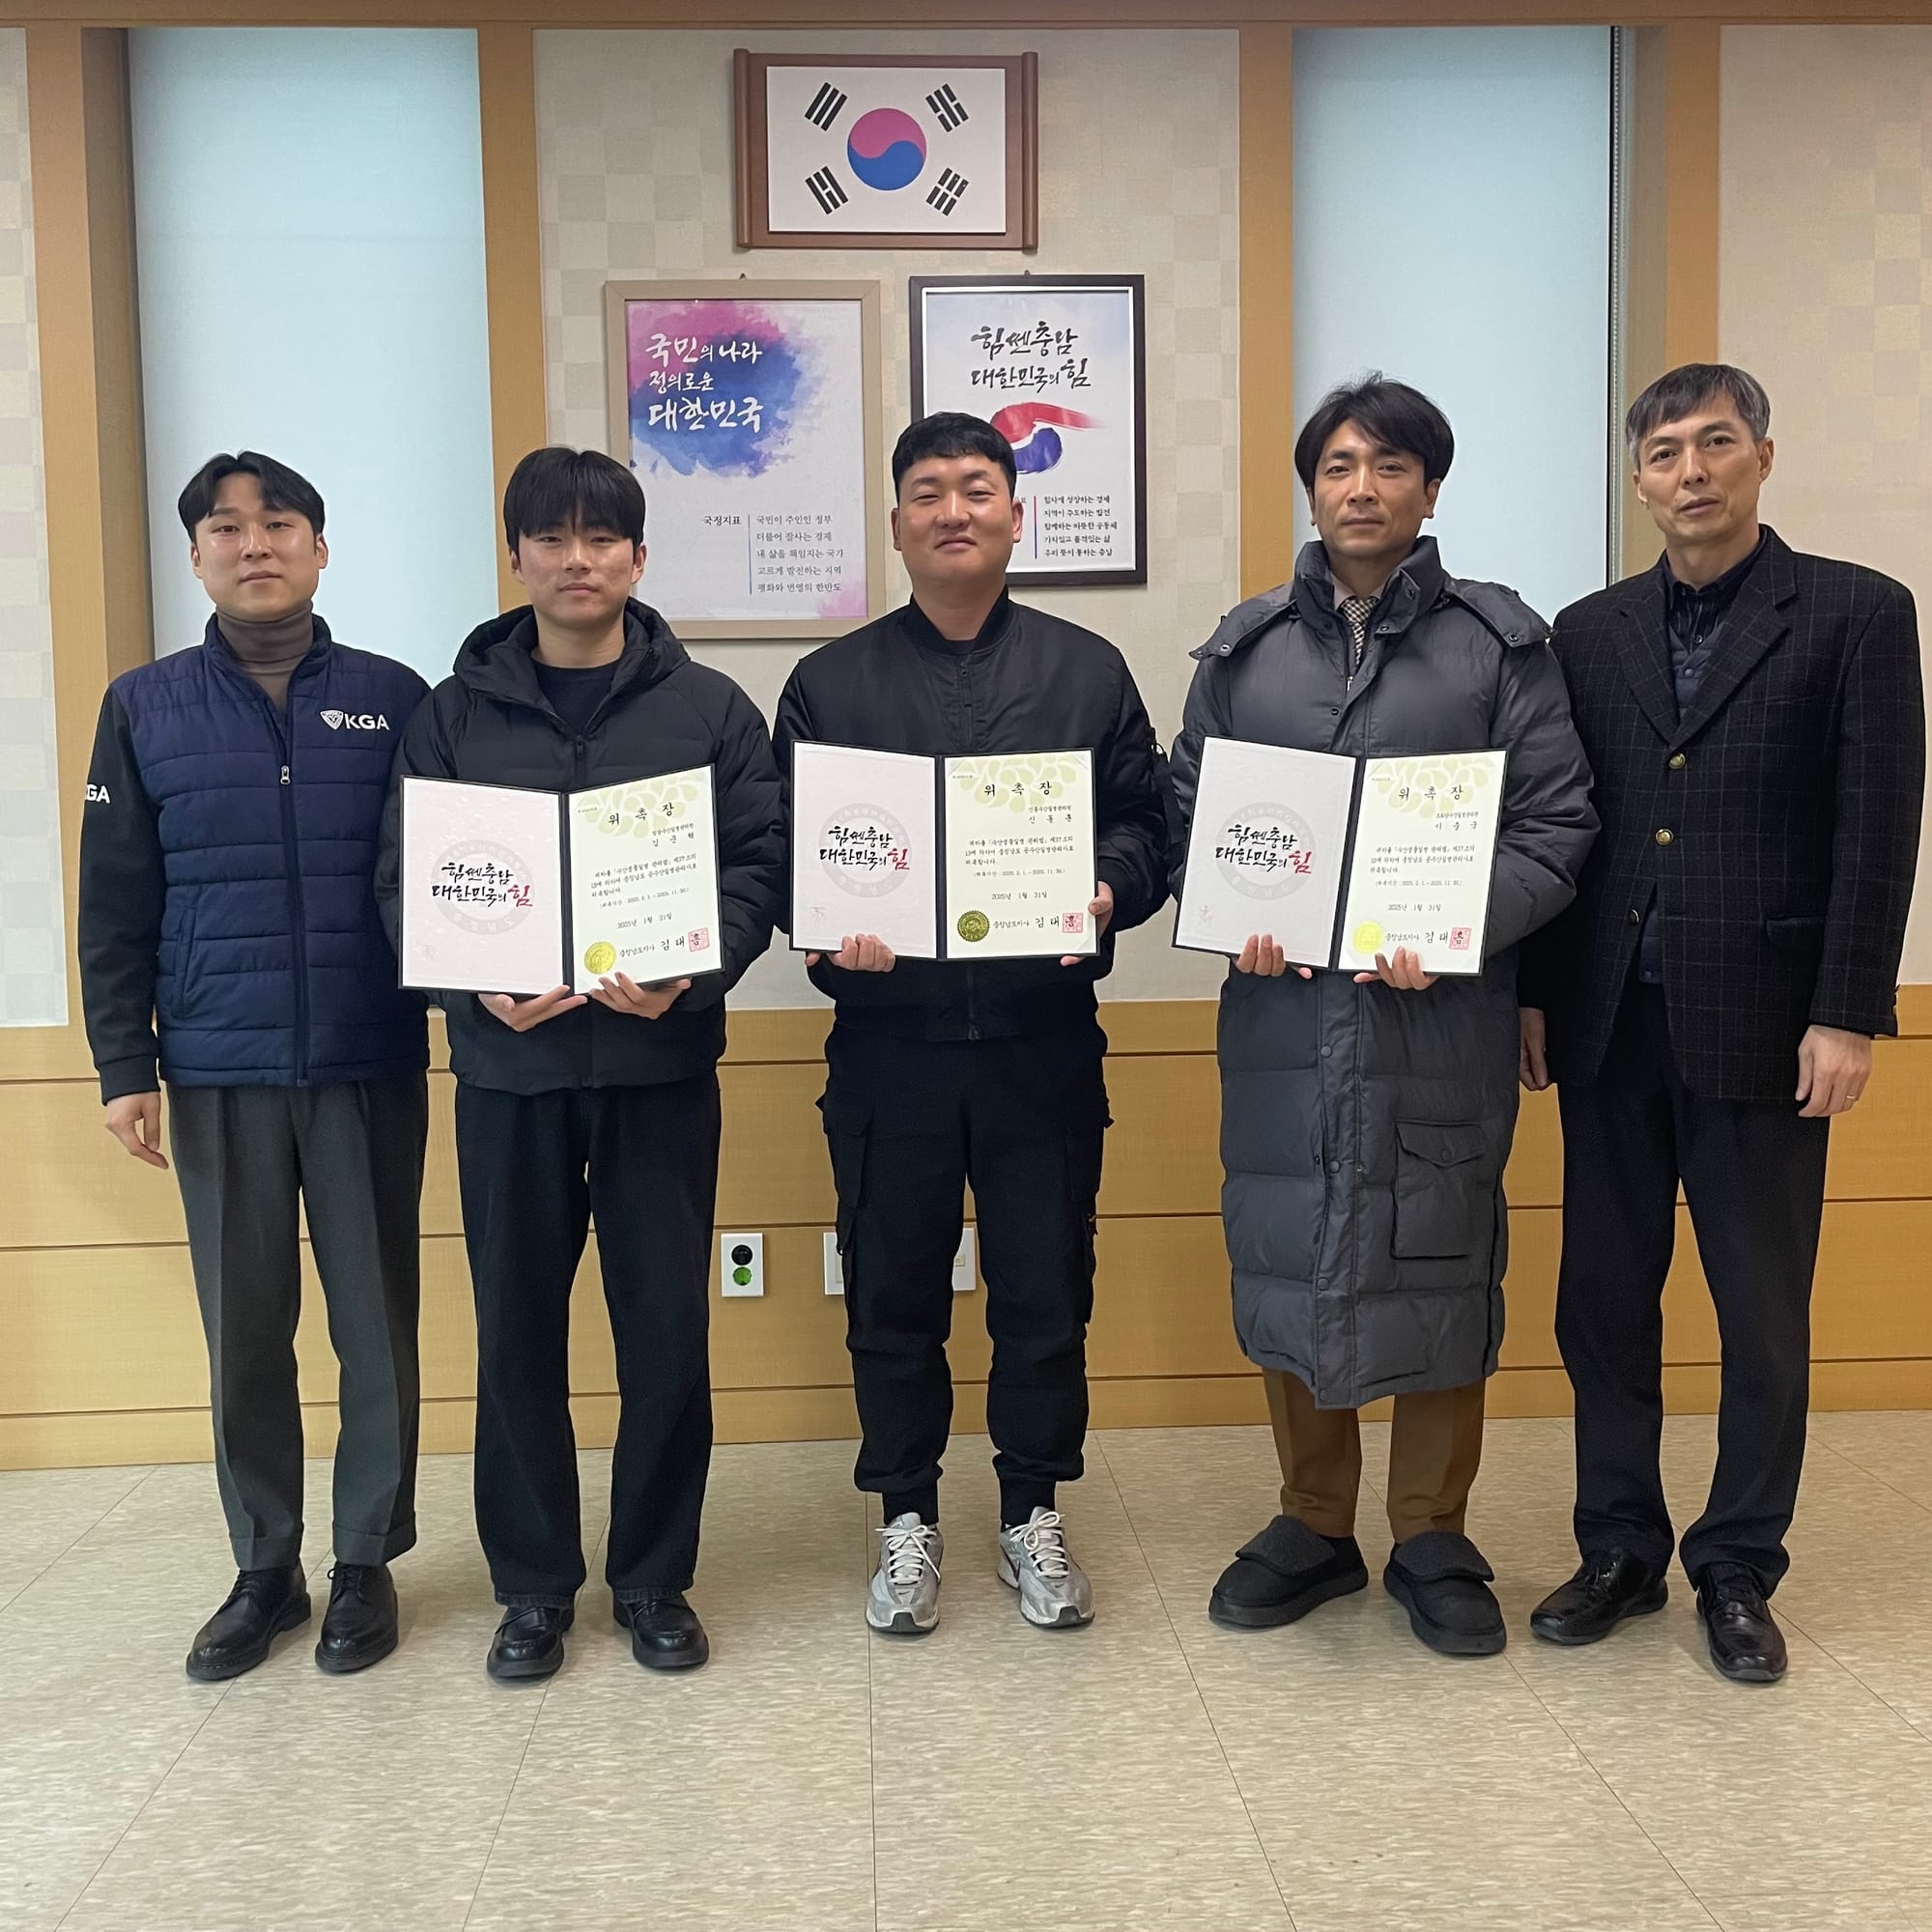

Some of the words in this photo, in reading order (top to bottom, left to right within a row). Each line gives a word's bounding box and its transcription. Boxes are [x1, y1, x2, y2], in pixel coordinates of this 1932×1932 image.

[645, 332, 713, 367] 국민의
[719, 340, 763, 364] 나라
[649, 371, 715, 394] 정의로운
[648, 396, 765, 433] 대한민국
[703, 515, 742, 526] 국정지표
[756, 514, 782, 526] 국민이
[785, 514, 811, 526] 주인인
[815, 514, 833, 526] 정부
[756, 531, 782, 542] 더불어
[785, 531, 811, 542] 잘사는
[815, 531, 833, 542] 경제
[757, 549, 765, 558] 내
[769, 549, 786, 558] 삶을
[789, 549, 823, 558] 책임지는
[827, 549, 843, 558] 국가
[757, 566, 784, 576] 고르게
[786, 566, 821, 576] 발전하는
[825, 566, 840, 576] 지역
[757, 582, 784, 593] 평화와
[786, 582, 812, 593] 번영의
[816, 582, 842, 593] 한반도
[344, 713, 390, 730] KGA
[86, 783, 110, 804] GA
